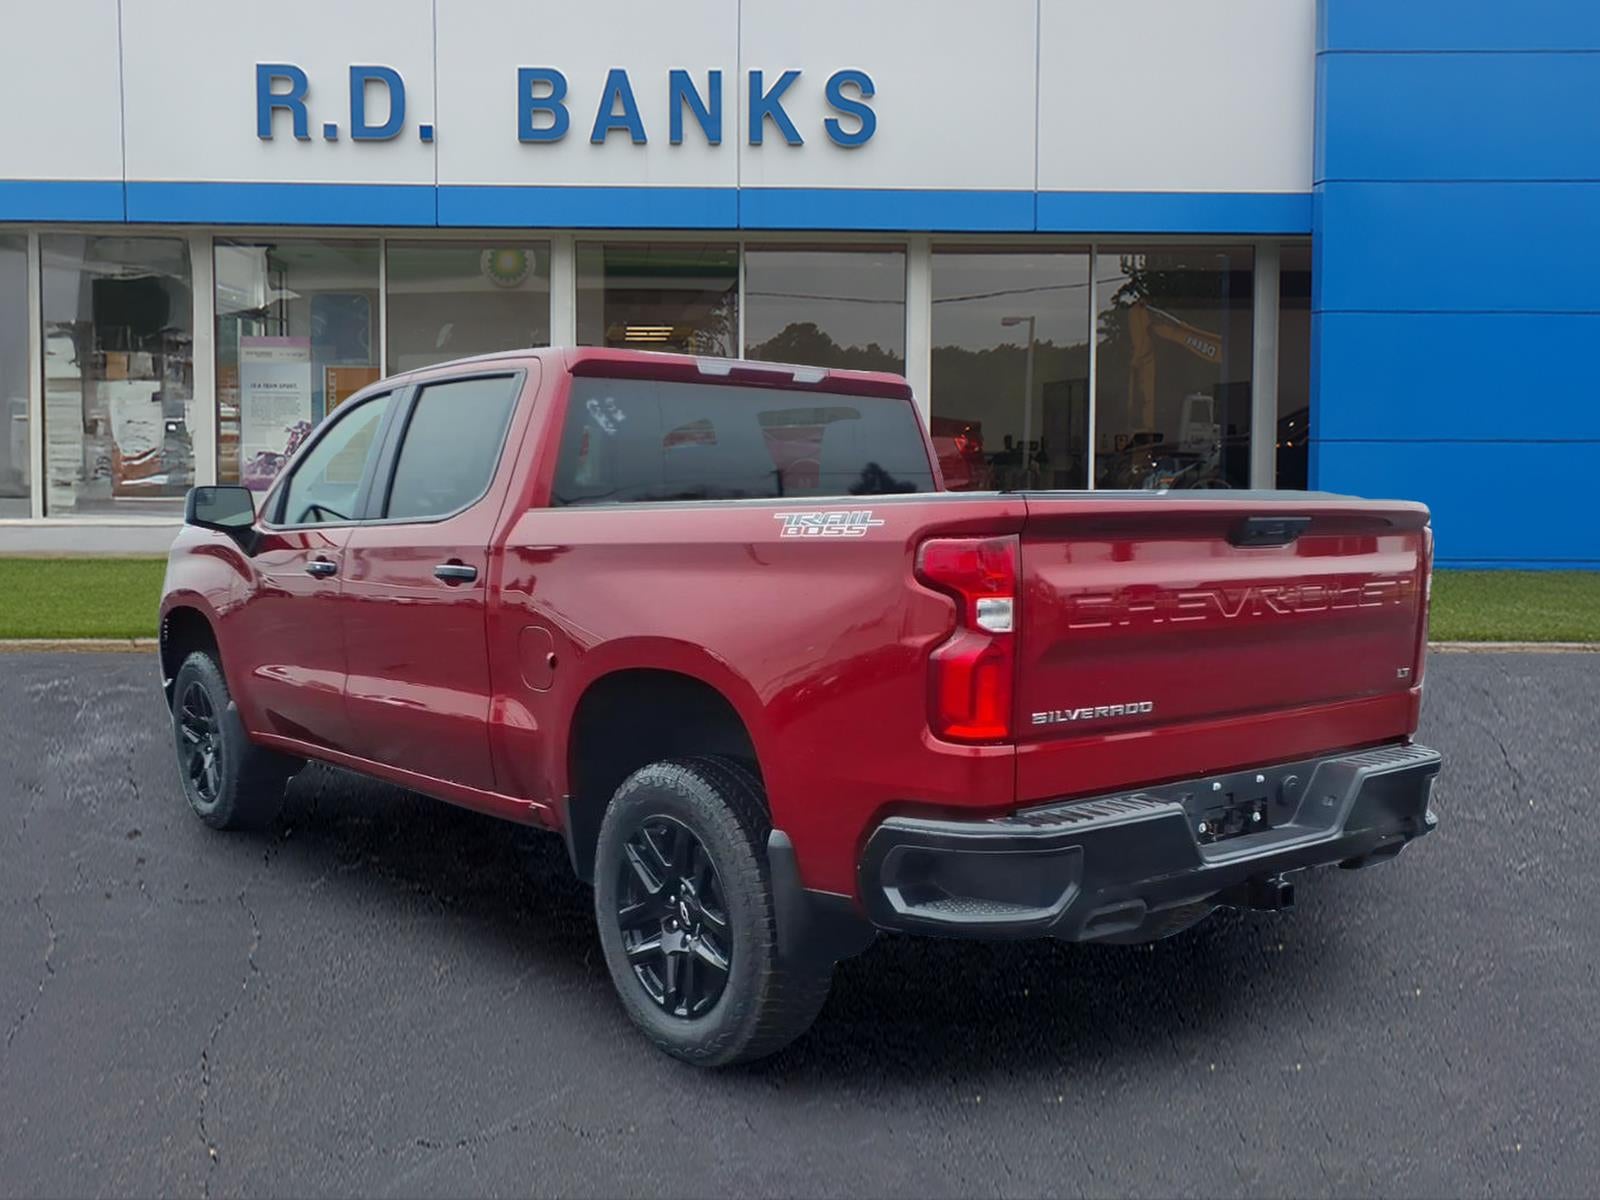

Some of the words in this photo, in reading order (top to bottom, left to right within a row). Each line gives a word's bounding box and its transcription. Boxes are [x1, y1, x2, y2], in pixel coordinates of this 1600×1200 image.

[255, 62, 434, 143] R.D.
[517, 66, 877, 149] BANKS
[774, 510, 885, 526] TRAIL
[780, 525, 868, 538] BOSS
[1068, 577, 1412, 629] CHEVROLET
[1031, 701, 1153, 725] SILVERADO
